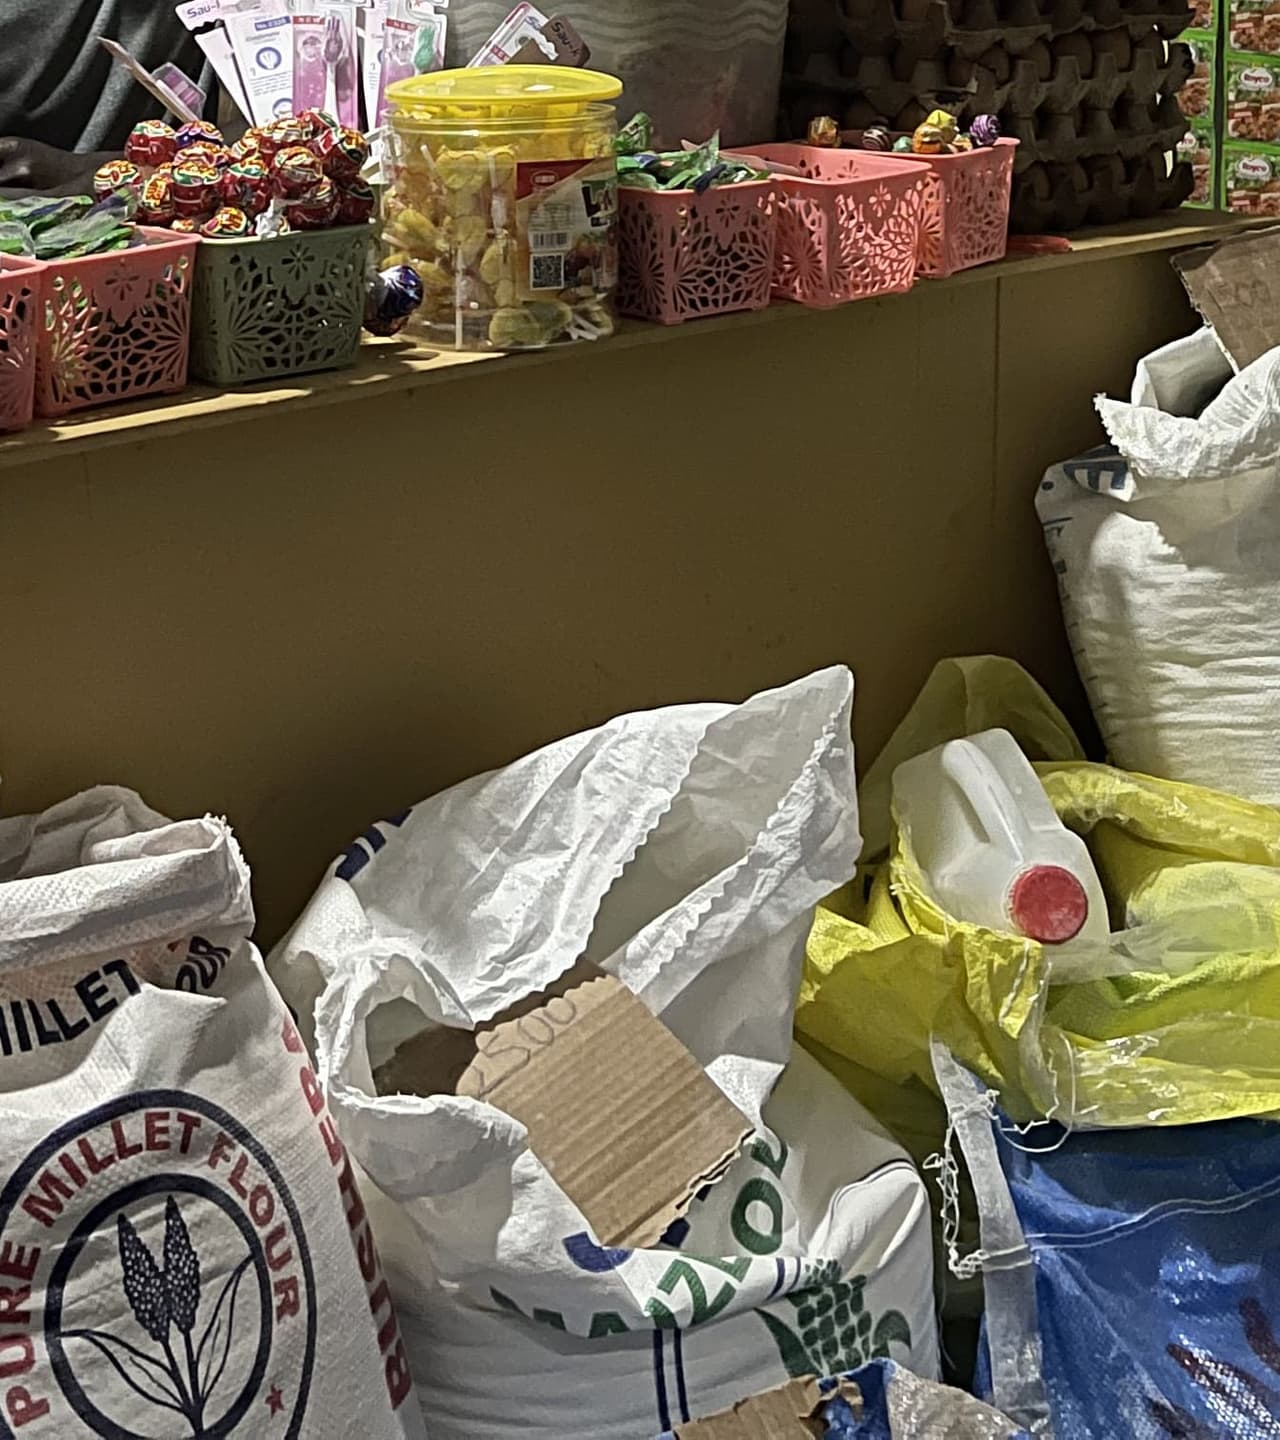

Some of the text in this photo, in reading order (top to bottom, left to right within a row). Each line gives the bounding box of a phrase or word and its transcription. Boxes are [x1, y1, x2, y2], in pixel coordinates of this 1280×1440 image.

[552, 21, 582, 58] Sau-k
[1244, 73, 1270, 84] Royco
[1242, 162, 1269, 174] Royco
[22, 1111, 203, 1228] MILLET
[206, 1129, 305, 1327] FLOUR
[282, 1017, 414, 1411] BUSHERA
